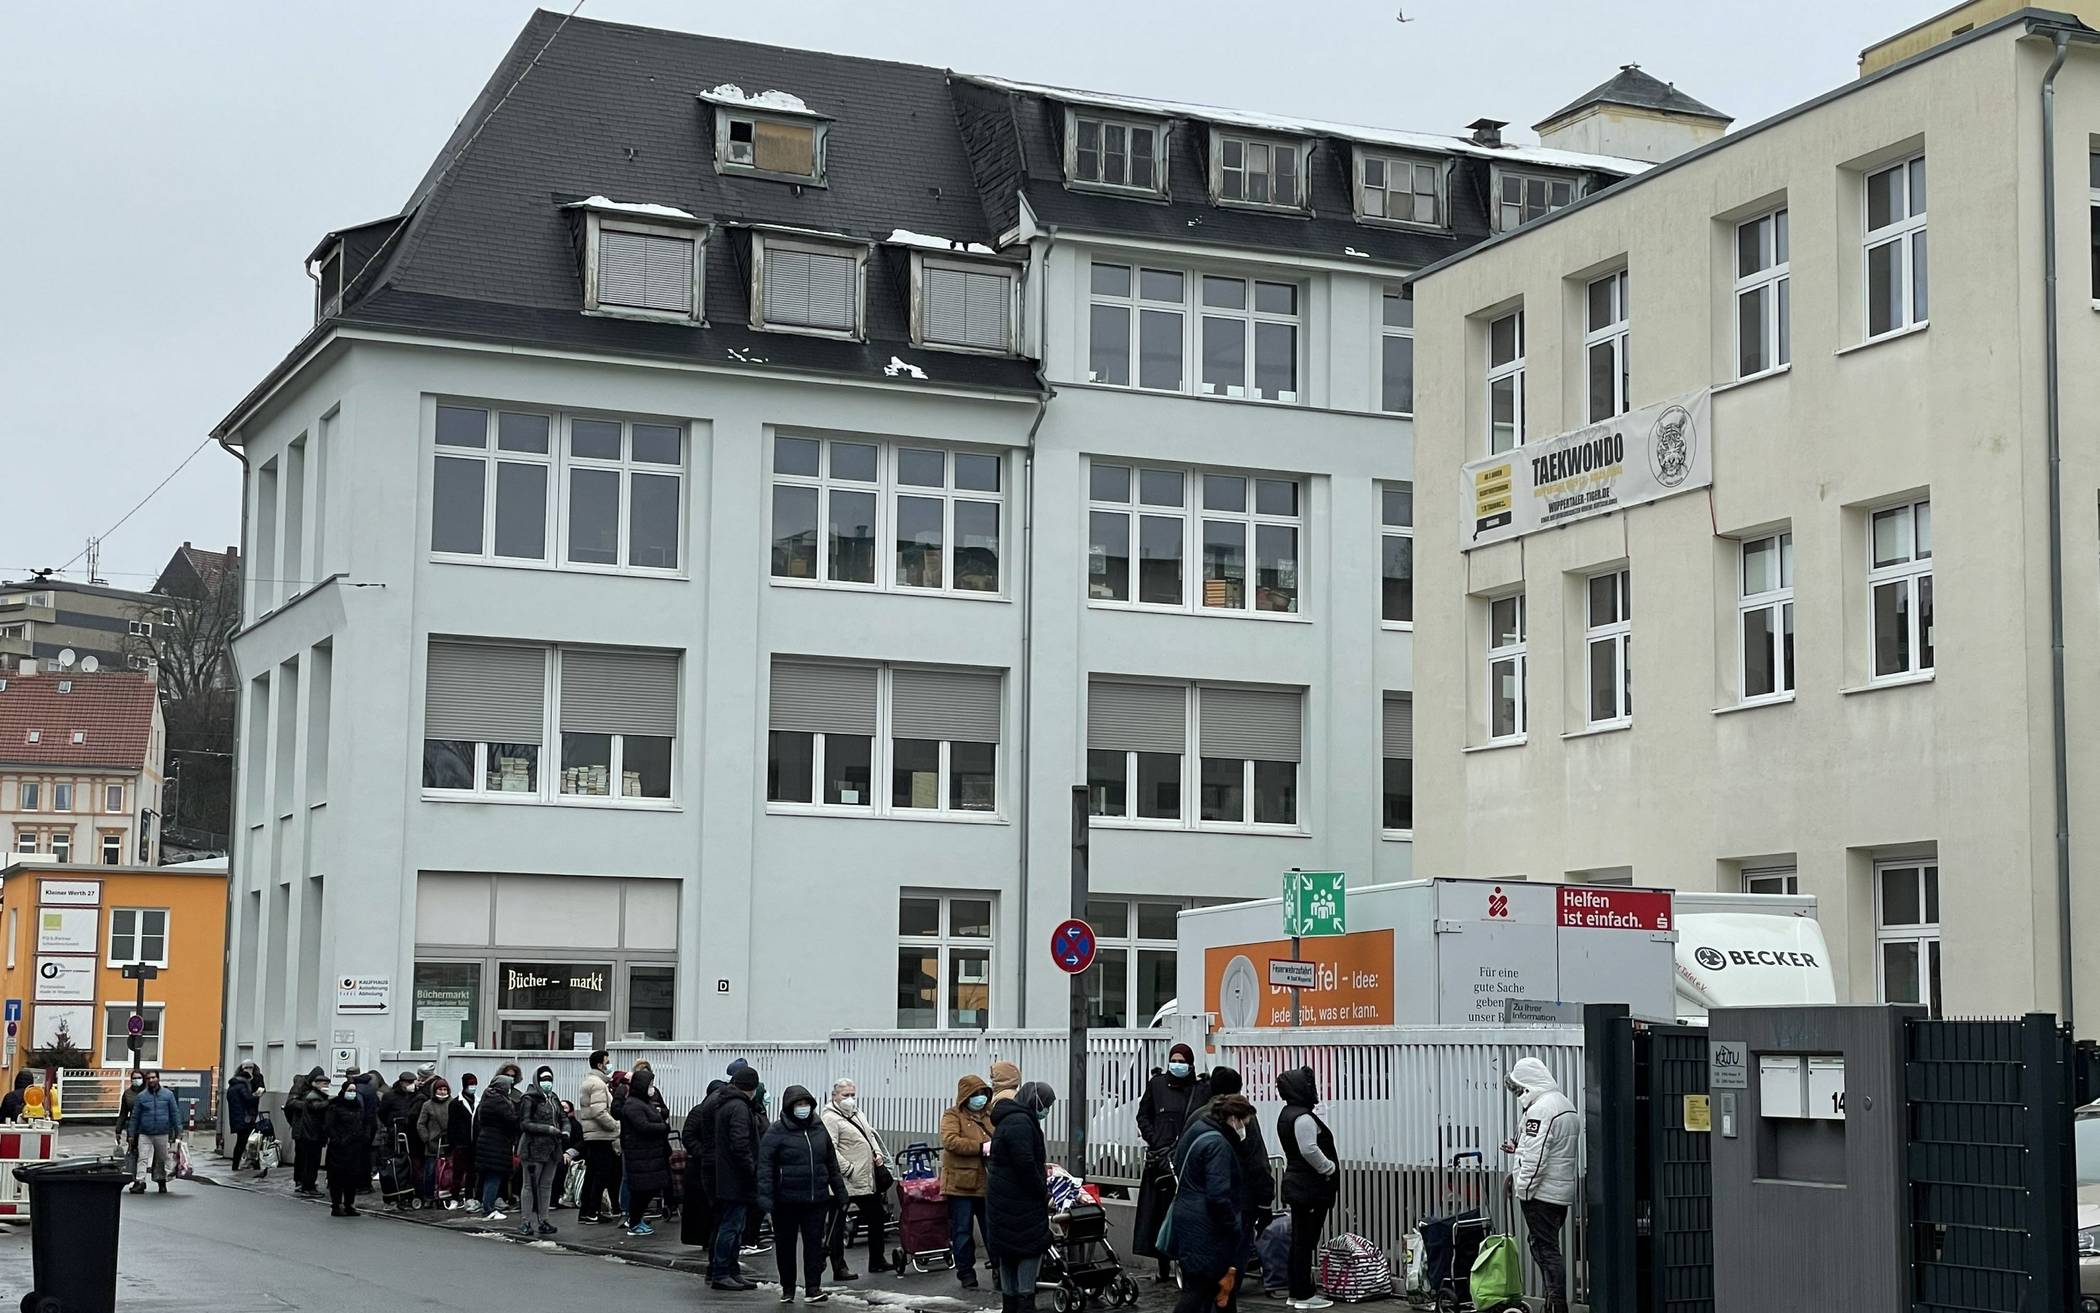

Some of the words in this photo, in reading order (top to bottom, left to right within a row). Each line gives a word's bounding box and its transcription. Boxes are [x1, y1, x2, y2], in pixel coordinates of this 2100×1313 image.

[1532, 432, 1624, 487] TAEKWONDO
[1563, 891, 1610, 909] Helfen
[1563, 909, 1583, 925] ist
[1586, 910, 1643, 928] einfach.
[1727, 950, 1820, 968] BECKER
[1272, 963, 1312, 976] Feuerwehrzufahrt
[1479, 966, 1496, 977] Für
[1498, 967, 1519, 978] eine
[507, 969, 548, 991] Bücher
[569, 971, 603, 992] markt
[1352, 970, 1379, 989] Idee:
[720, 981, 728, 991] D
[1473, 982, 1495, 994] gute
[1496, 982, 1525, 993] Sache
[416, 989, 470, 999] Büchermarkt
[1475, 997, 1504, 1009] geben
[1512, 1003, 1523, 1011] Zu
[1524, 1003, 1542, 1012] Ihrer
[1270, 1007, 1292, 1025] Jede
[1319, 1007, 1338, 1020] was
[1339, 1006, 1351, 1019] er
[1352, 1002, 1379, 1018] kann.
[1468, 1013, 1496, 1022] unser
[1512, 1012, 1556, 1021] Information
[1831, 1091, 1846, 1114] 14
[1526, 1121, 1539, 1131] 23
